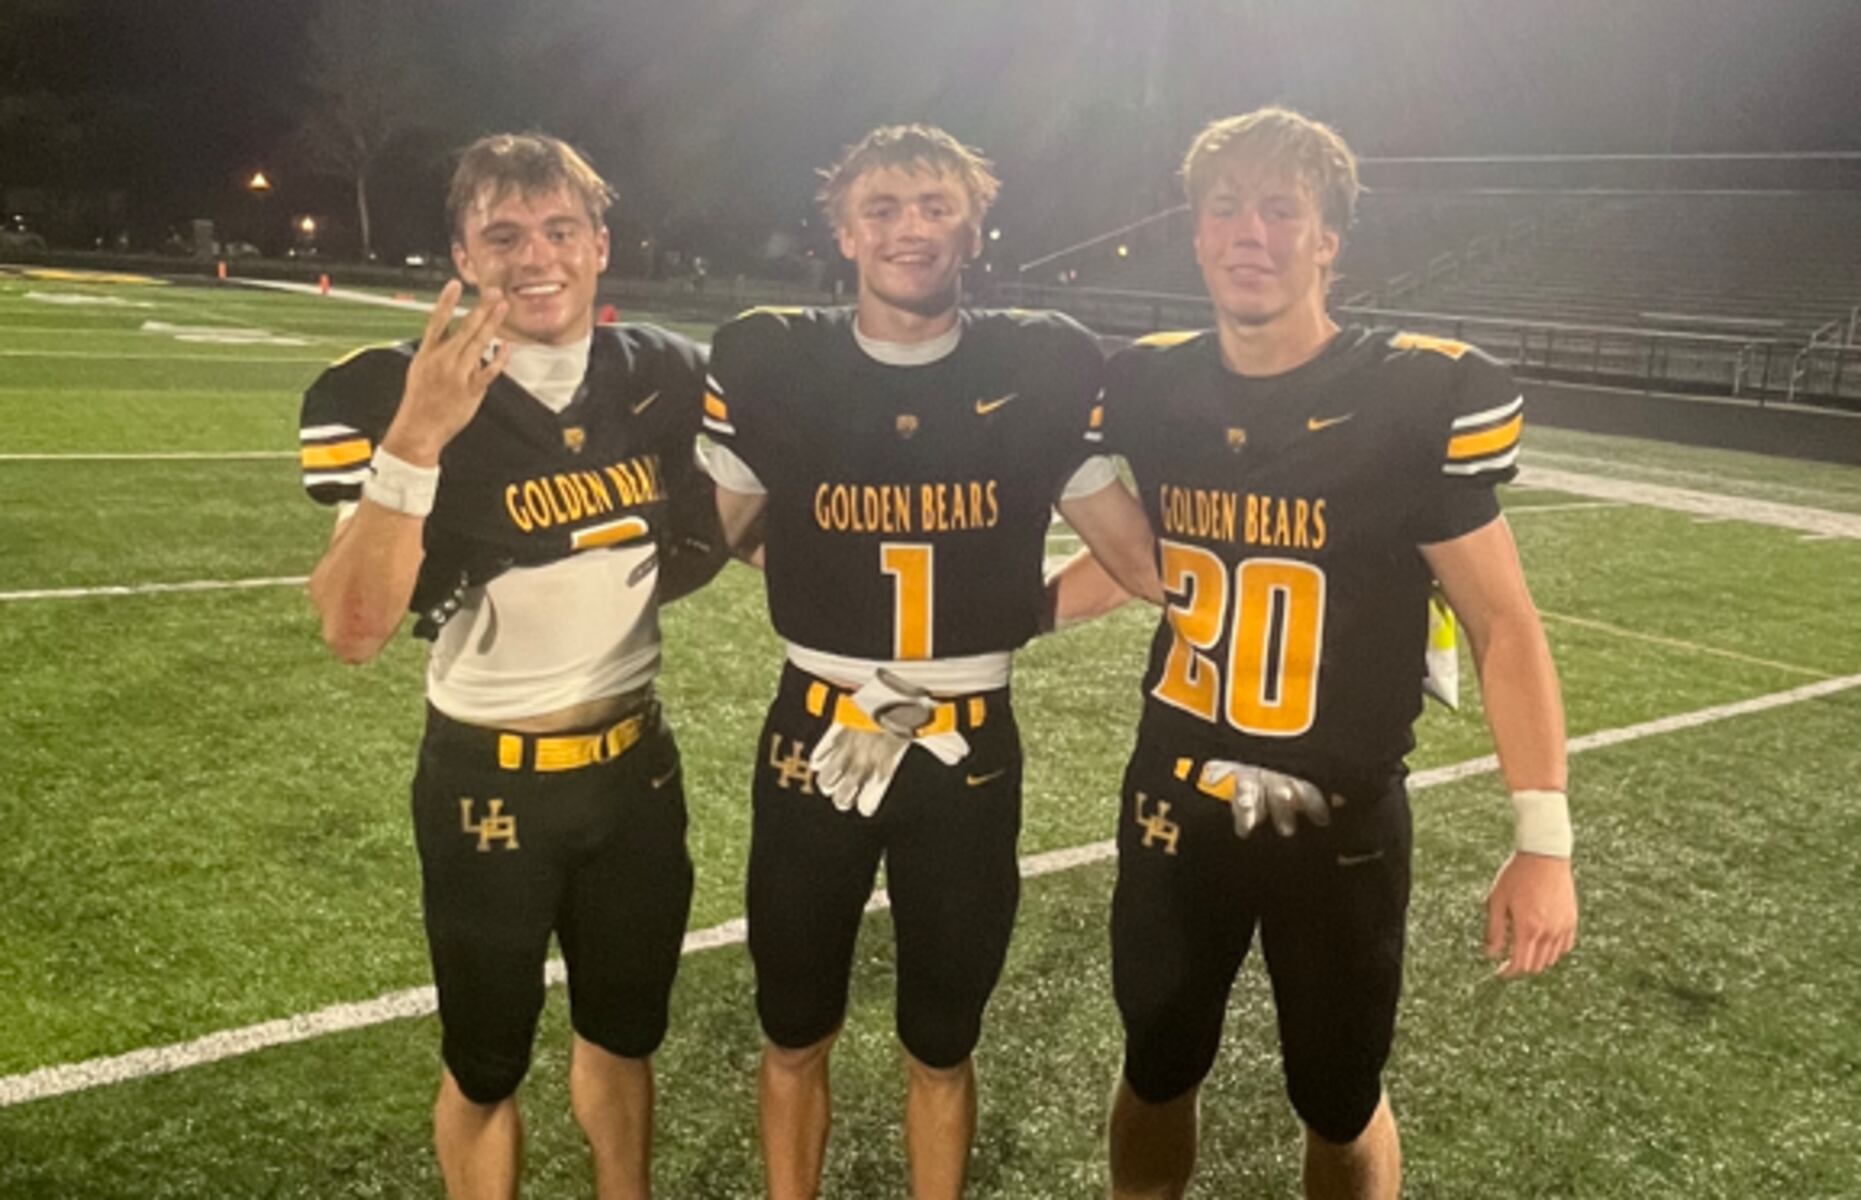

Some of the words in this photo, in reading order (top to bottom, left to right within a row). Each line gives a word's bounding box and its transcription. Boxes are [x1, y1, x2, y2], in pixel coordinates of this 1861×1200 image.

[505, 471, 614, 533] GOLDEN
[814, 482, 911, 533] GOLDEN
[920, 479, 999, 532] BEARS
[1160, 484, 1237, 543] GOLDEN
[1244, 493, 1327, 550] BEARS
[880, 541, 934, 661] 1
[1151, 538, 1327, 737] 20
